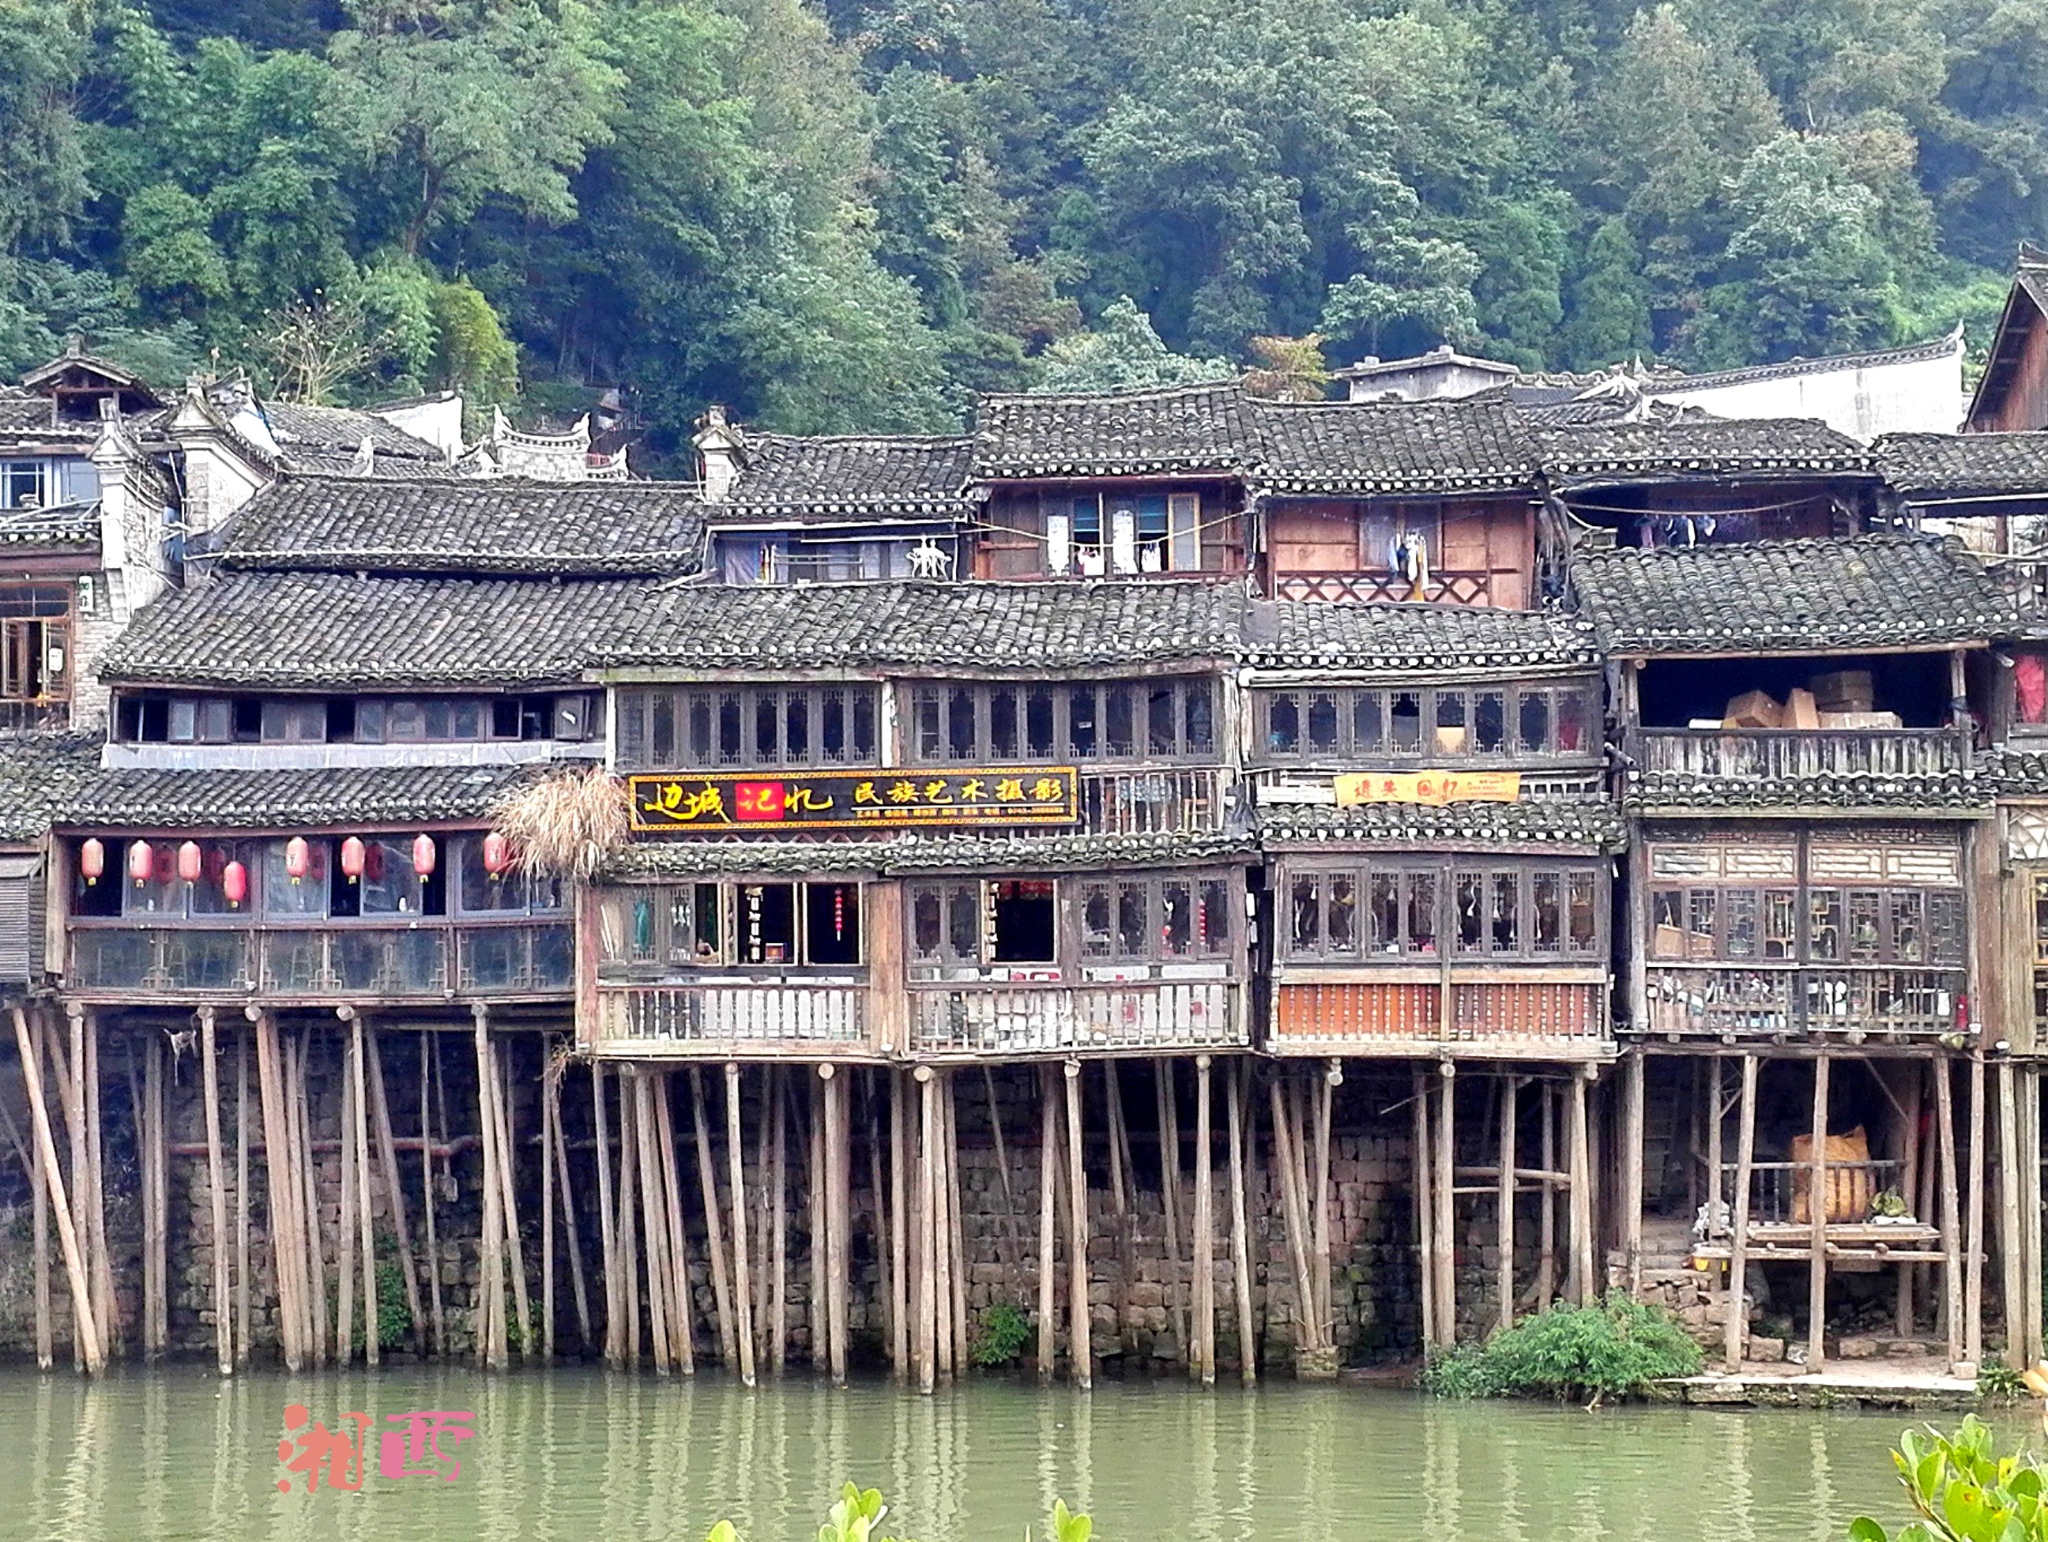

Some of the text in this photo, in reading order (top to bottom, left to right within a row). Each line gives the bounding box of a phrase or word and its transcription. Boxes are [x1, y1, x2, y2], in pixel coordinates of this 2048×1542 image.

[644, 778, 1064, 823] 边城记忆 民族艺术摄影
